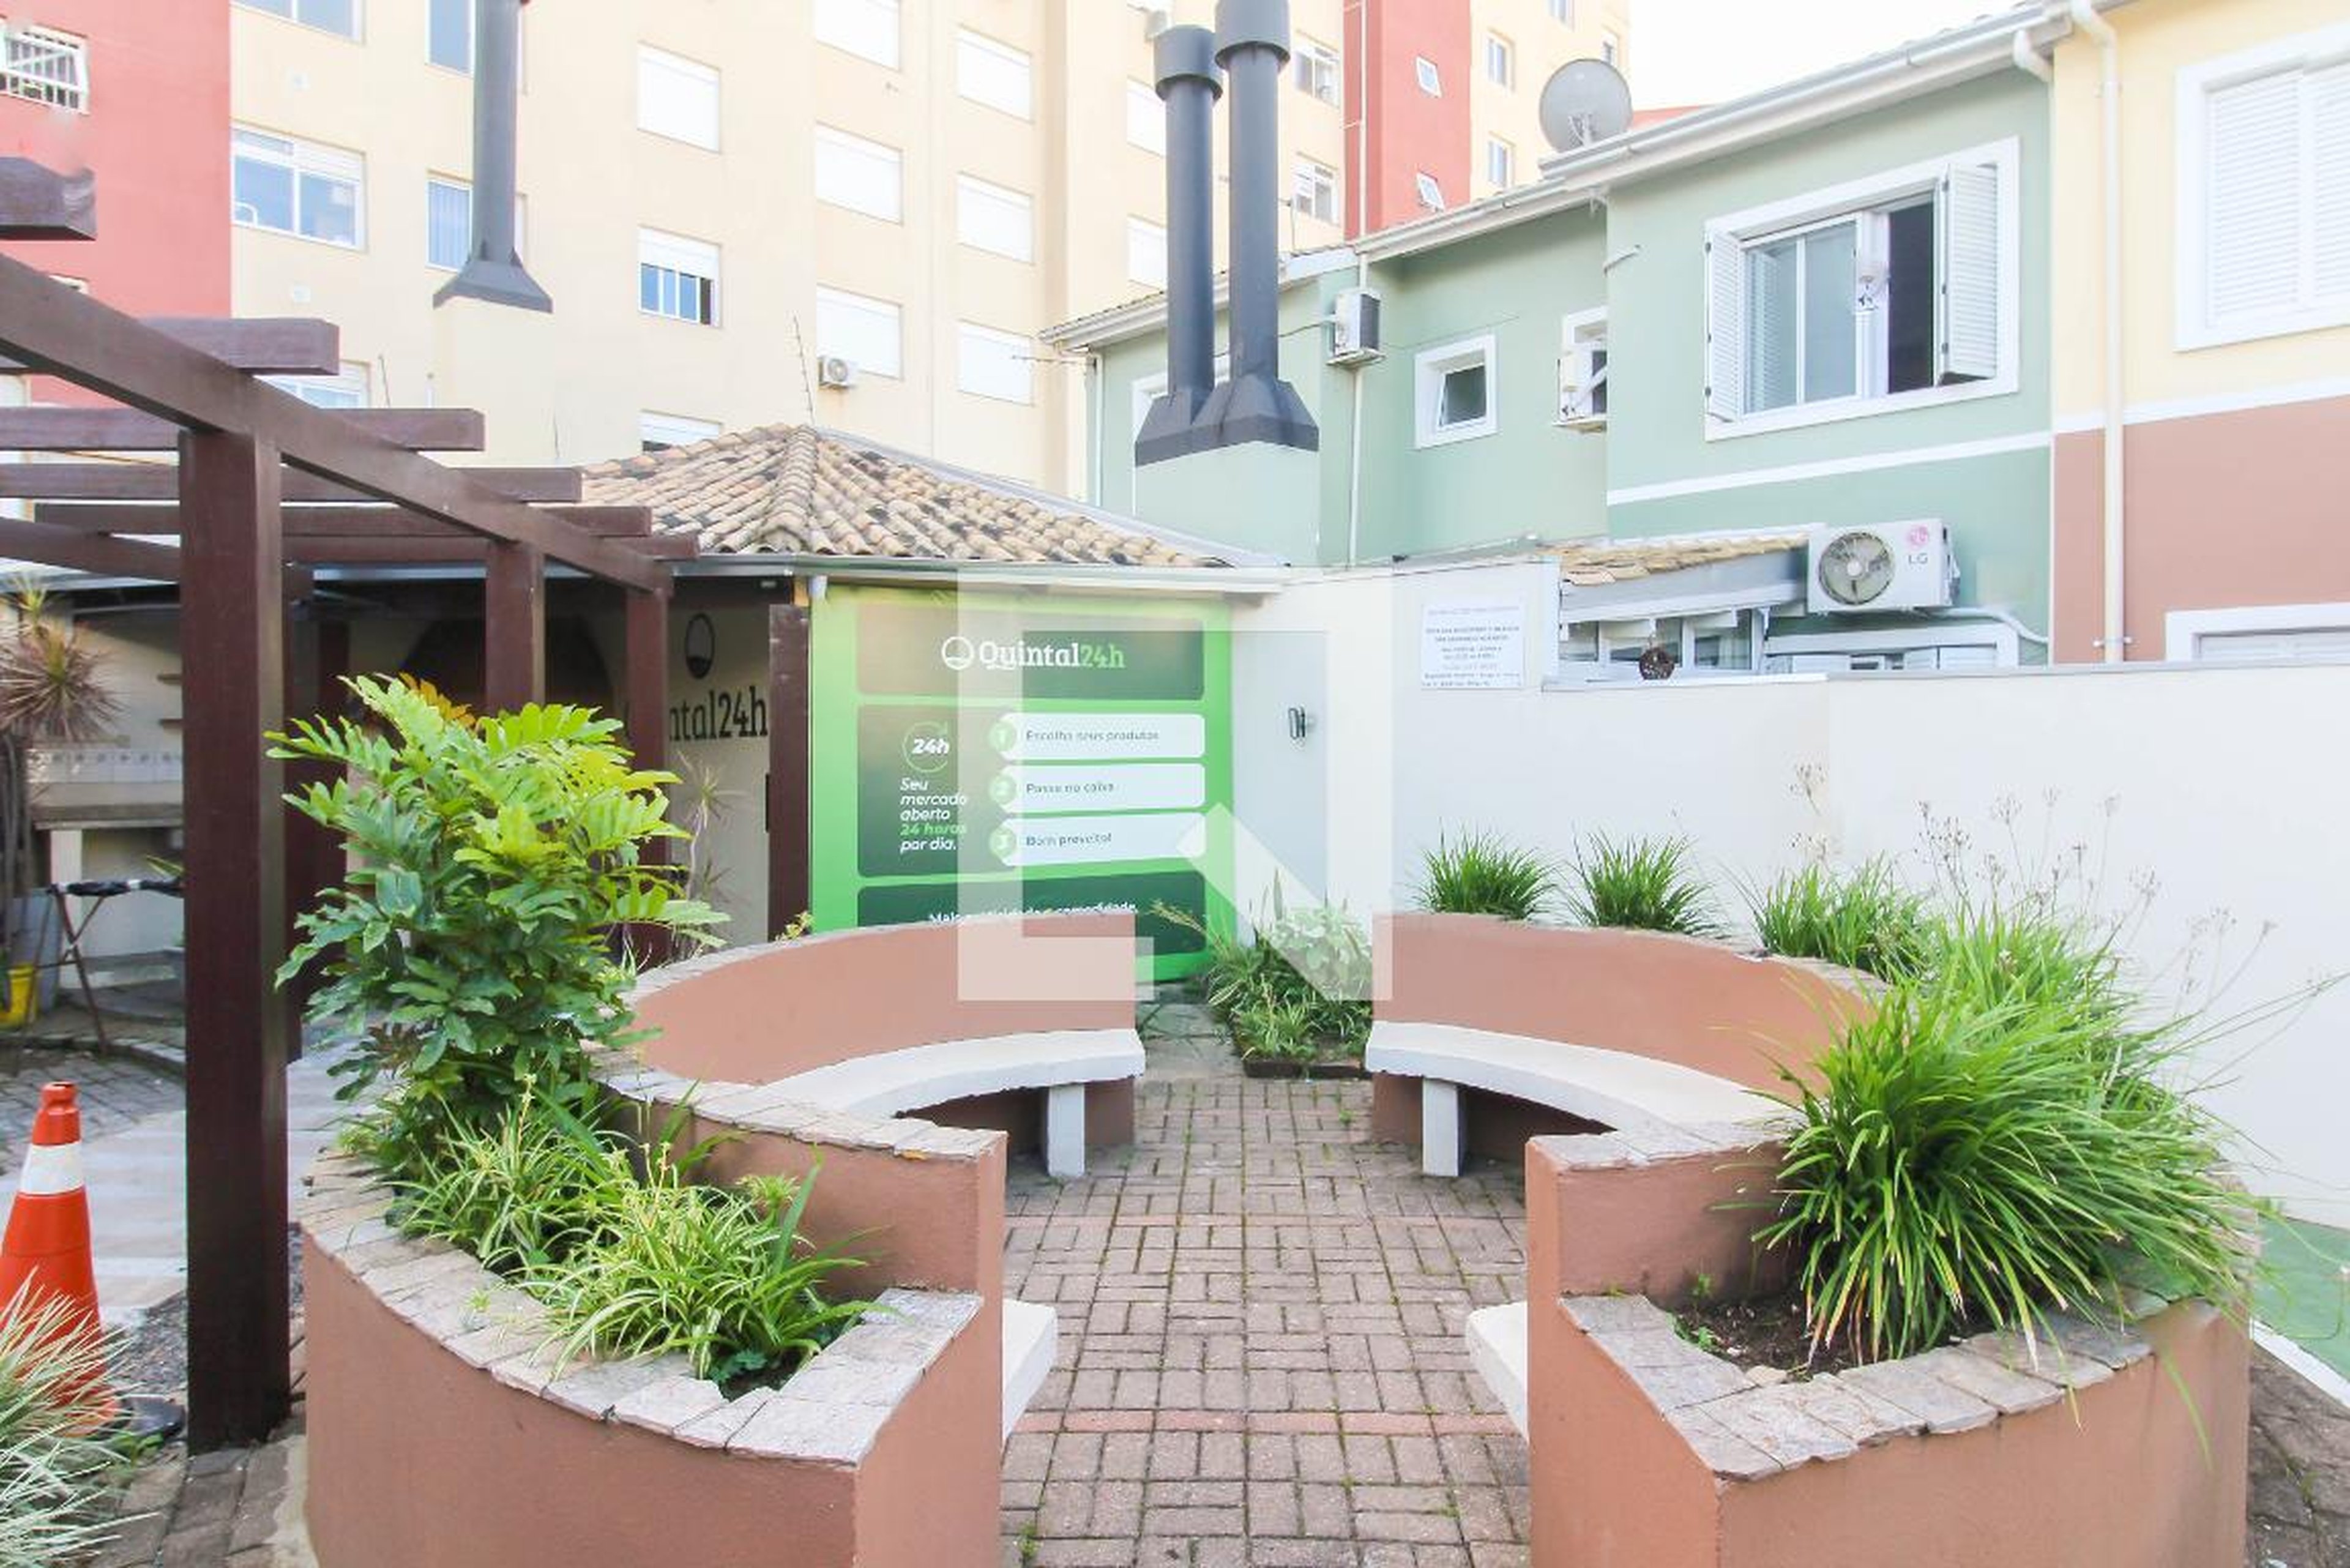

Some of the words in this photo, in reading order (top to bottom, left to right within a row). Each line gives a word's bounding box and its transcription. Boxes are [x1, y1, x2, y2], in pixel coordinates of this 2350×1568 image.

[1908, 552, 1928, 564] LG
[979, 640, 1125, 670] Quintal24h
[1026, 730, 1073, 741] Escolha
[1105, 730, 1159, 742] produtos
[912, 737, 950, 754] 24h
[900, 777, 929, 791] Seu
[1026, 783, 1062, 794] Passe
[1064, 784, 1081, 793] no
[1083, 781, 1114, 793] caixa
[900, 791, 968, 805] mercado
[900, 808, 951, 821] aberto
[900, 823, 920, 836] 24
[923, 822, 967, 835] horas
[900, 839, 927, 854] por
[930, 836, 957, 851] dia.
